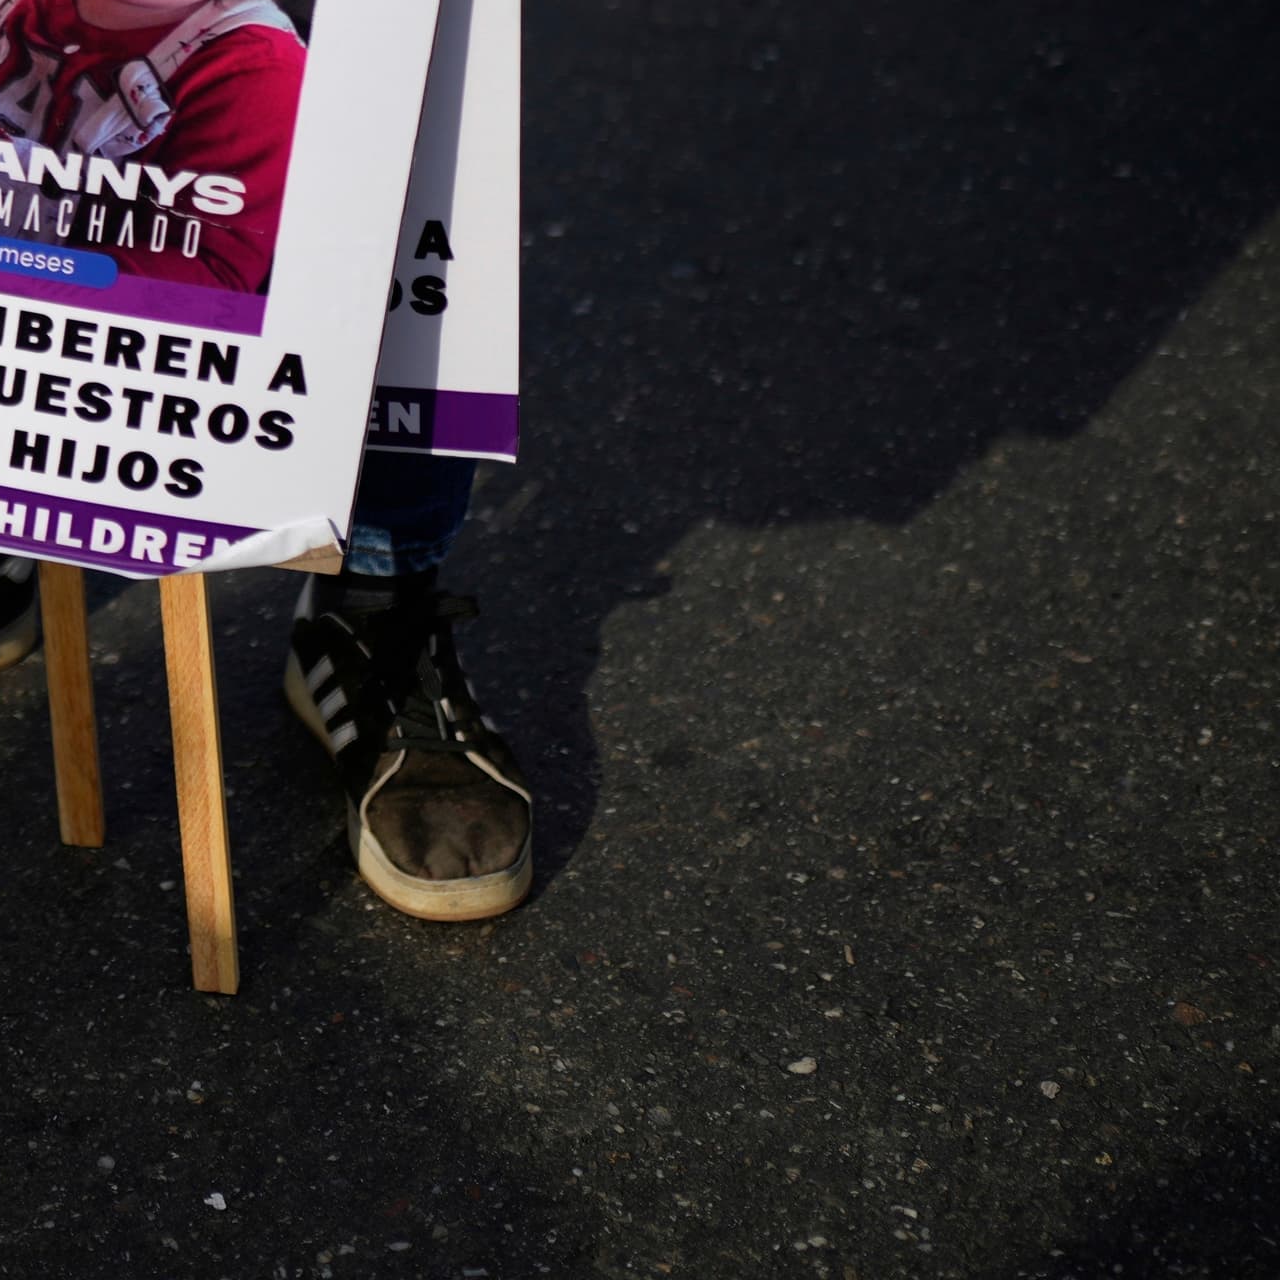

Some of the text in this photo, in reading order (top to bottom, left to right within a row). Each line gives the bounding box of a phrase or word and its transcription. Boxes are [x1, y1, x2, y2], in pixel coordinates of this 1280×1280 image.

[414, 220, 454, 260] A
[267, 353, 307, 395] A
[9, 429, 205, 499] HIJOS
